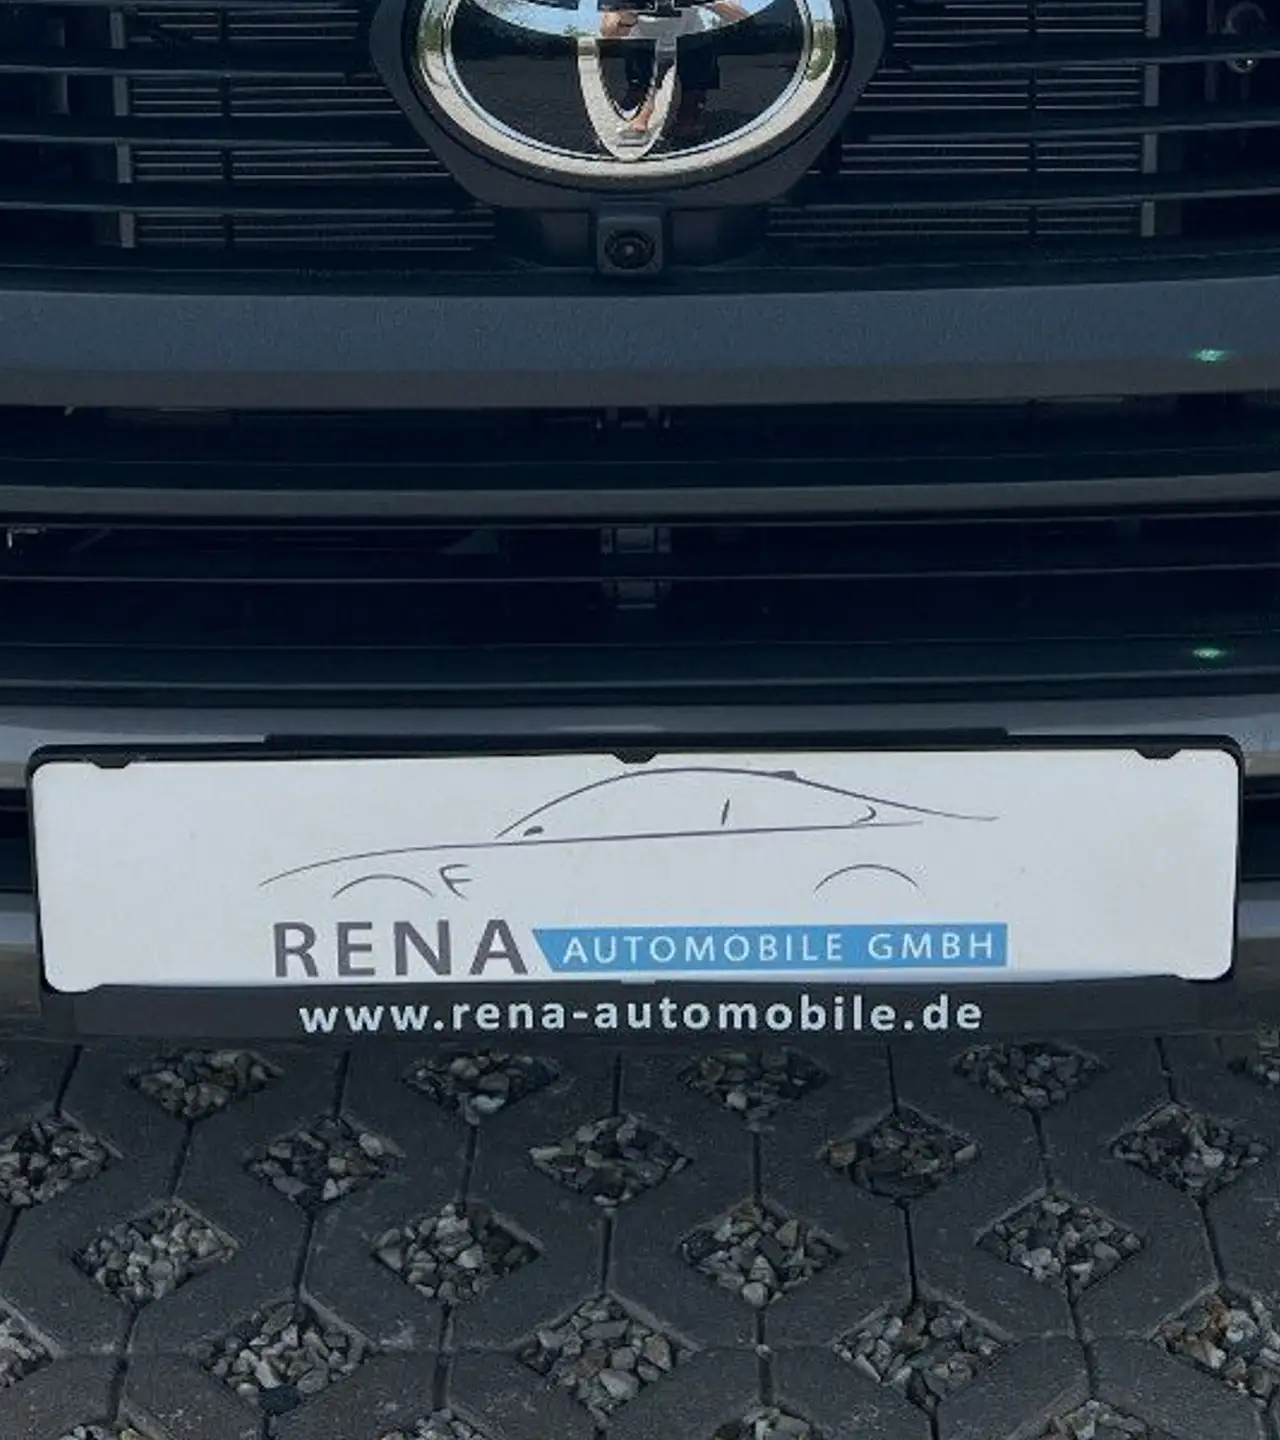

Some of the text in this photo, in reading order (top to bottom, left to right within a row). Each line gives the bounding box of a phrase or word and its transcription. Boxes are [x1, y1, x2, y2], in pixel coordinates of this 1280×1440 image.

[273, 919, 993, 977] RENA AUTOMOBILE GMBH
[298, 993, 983, 1033] www.rena-automobile.de
